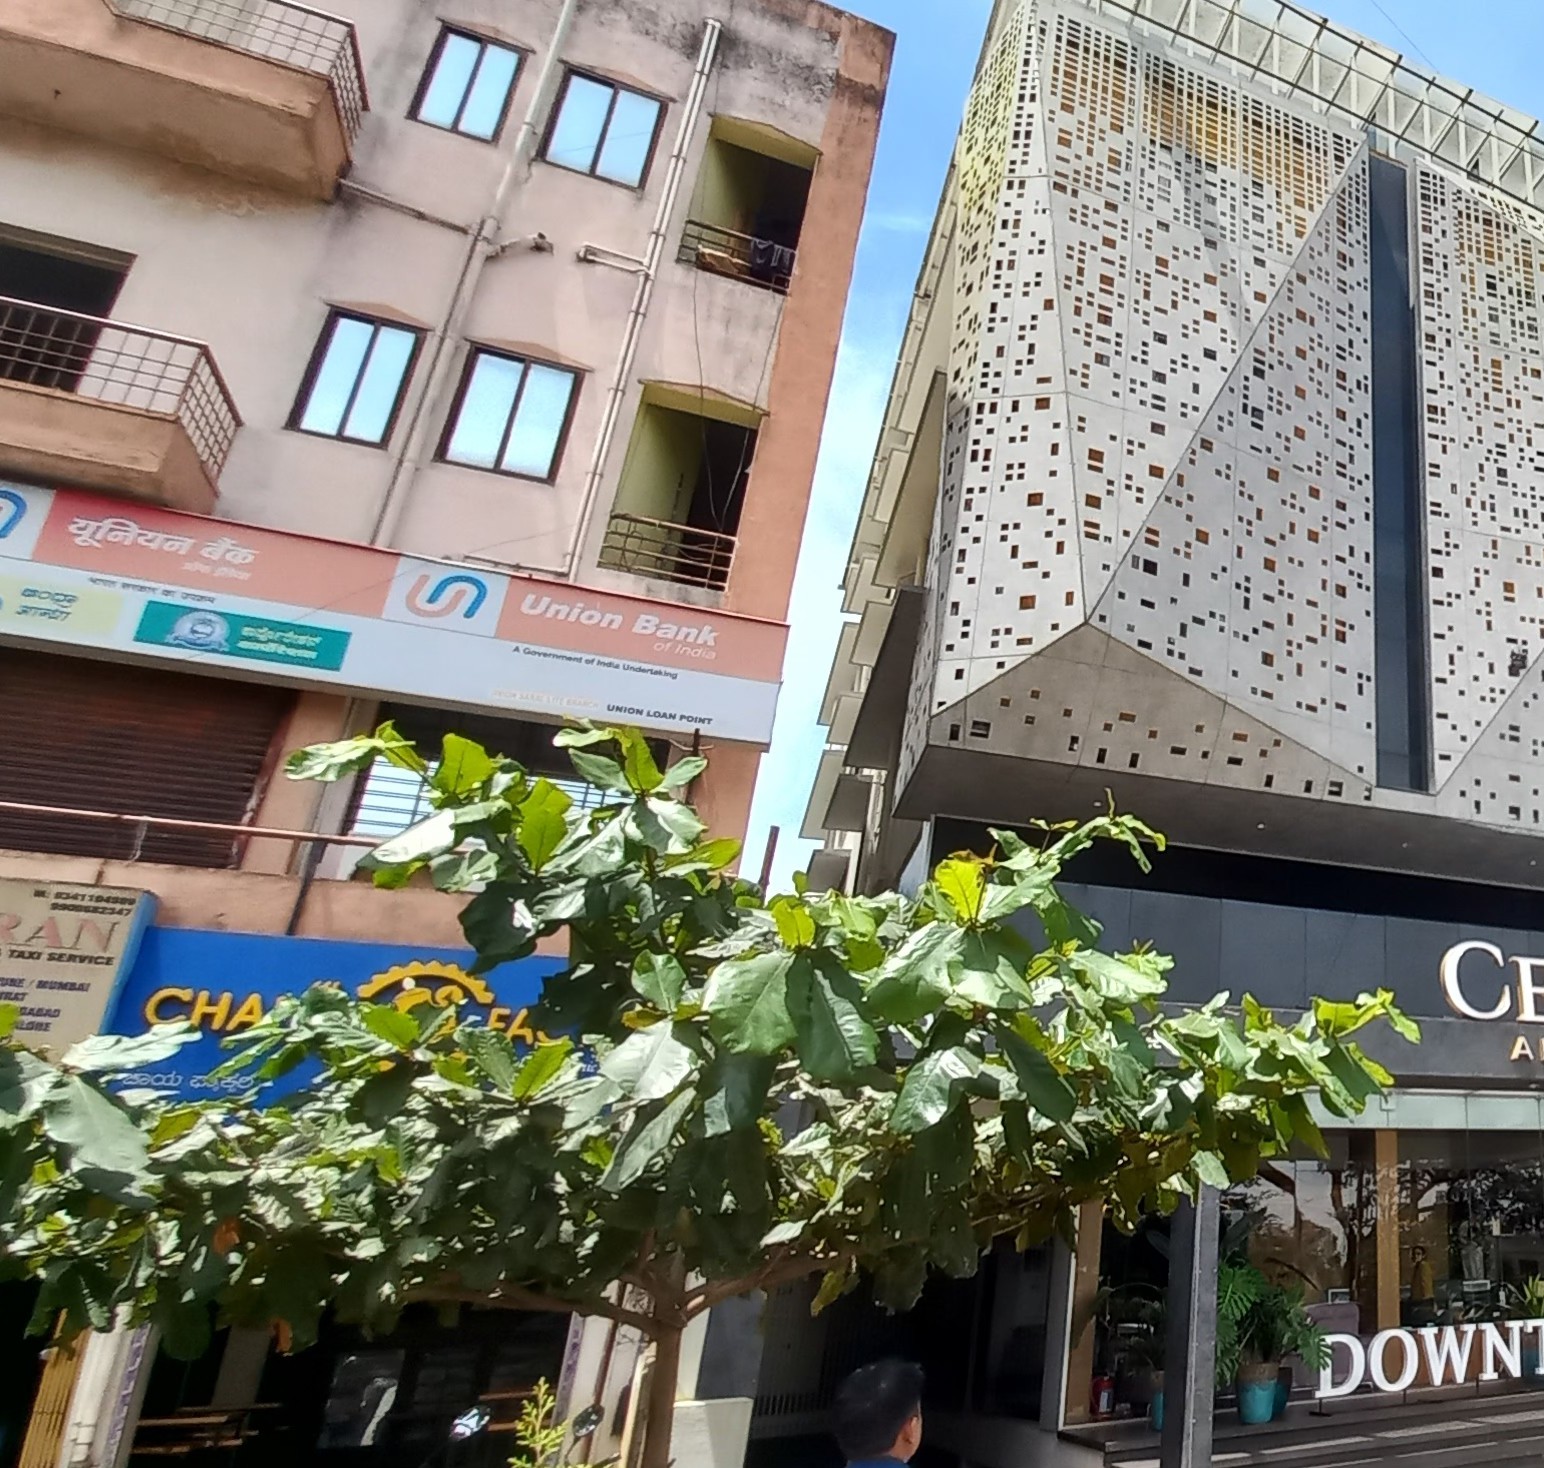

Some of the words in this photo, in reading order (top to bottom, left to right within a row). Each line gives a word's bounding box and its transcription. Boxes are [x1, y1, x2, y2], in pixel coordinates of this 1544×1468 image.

[68, 517, 197, 555] यूनियन
[200, 536, 259, 564] बैंक
[519, 594, 623, 629] Union
[632, 614, 719, 647] Bank
[512, 645, 520, 653] A
[523, 647, 582, 664] Government
[585, 657, 595, 666] of
[597, 659, 620, 670] India
[623, 663, 678, 680] Undertaking
[654, 641, 671, 653] of
[674, 643, 716, 660] India
[606, 704, 644, 716] UNION
[647, 709, 677, 721] LOAN
[680, 714, 713, 726] POINT
[8, 949, 42, 961] TAXI
[47, 952, 115, 966] SERVICE
[144, 987, 289, 1032] CHA
[1510, 1035, 1534, 1061] A
